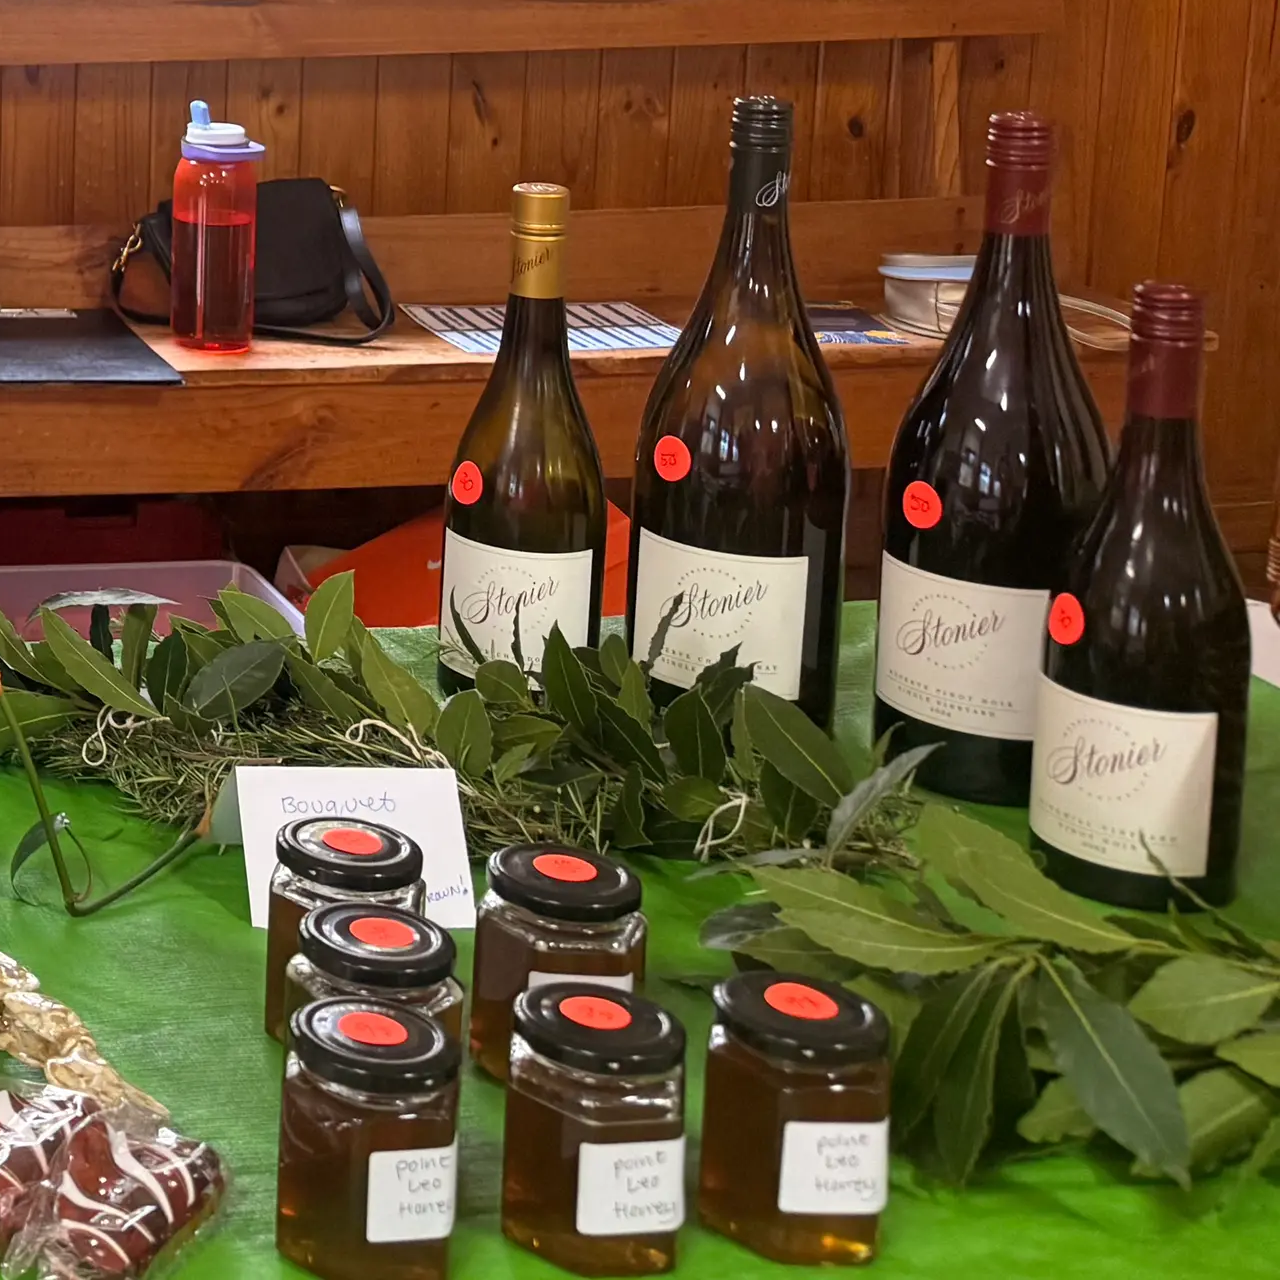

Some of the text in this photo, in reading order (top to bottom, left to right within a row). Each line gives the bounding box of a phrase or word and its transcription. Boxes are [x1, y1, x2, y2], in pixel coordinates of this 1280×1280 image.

[461, 576, 560, 624] Stonier
[659, 579, 770, 628] Stonier
[896, 609, 1006, 656] Stonier
[1046, 736, 1167, 785] Stonier
[281, 791, 397, 818] Bouquet
